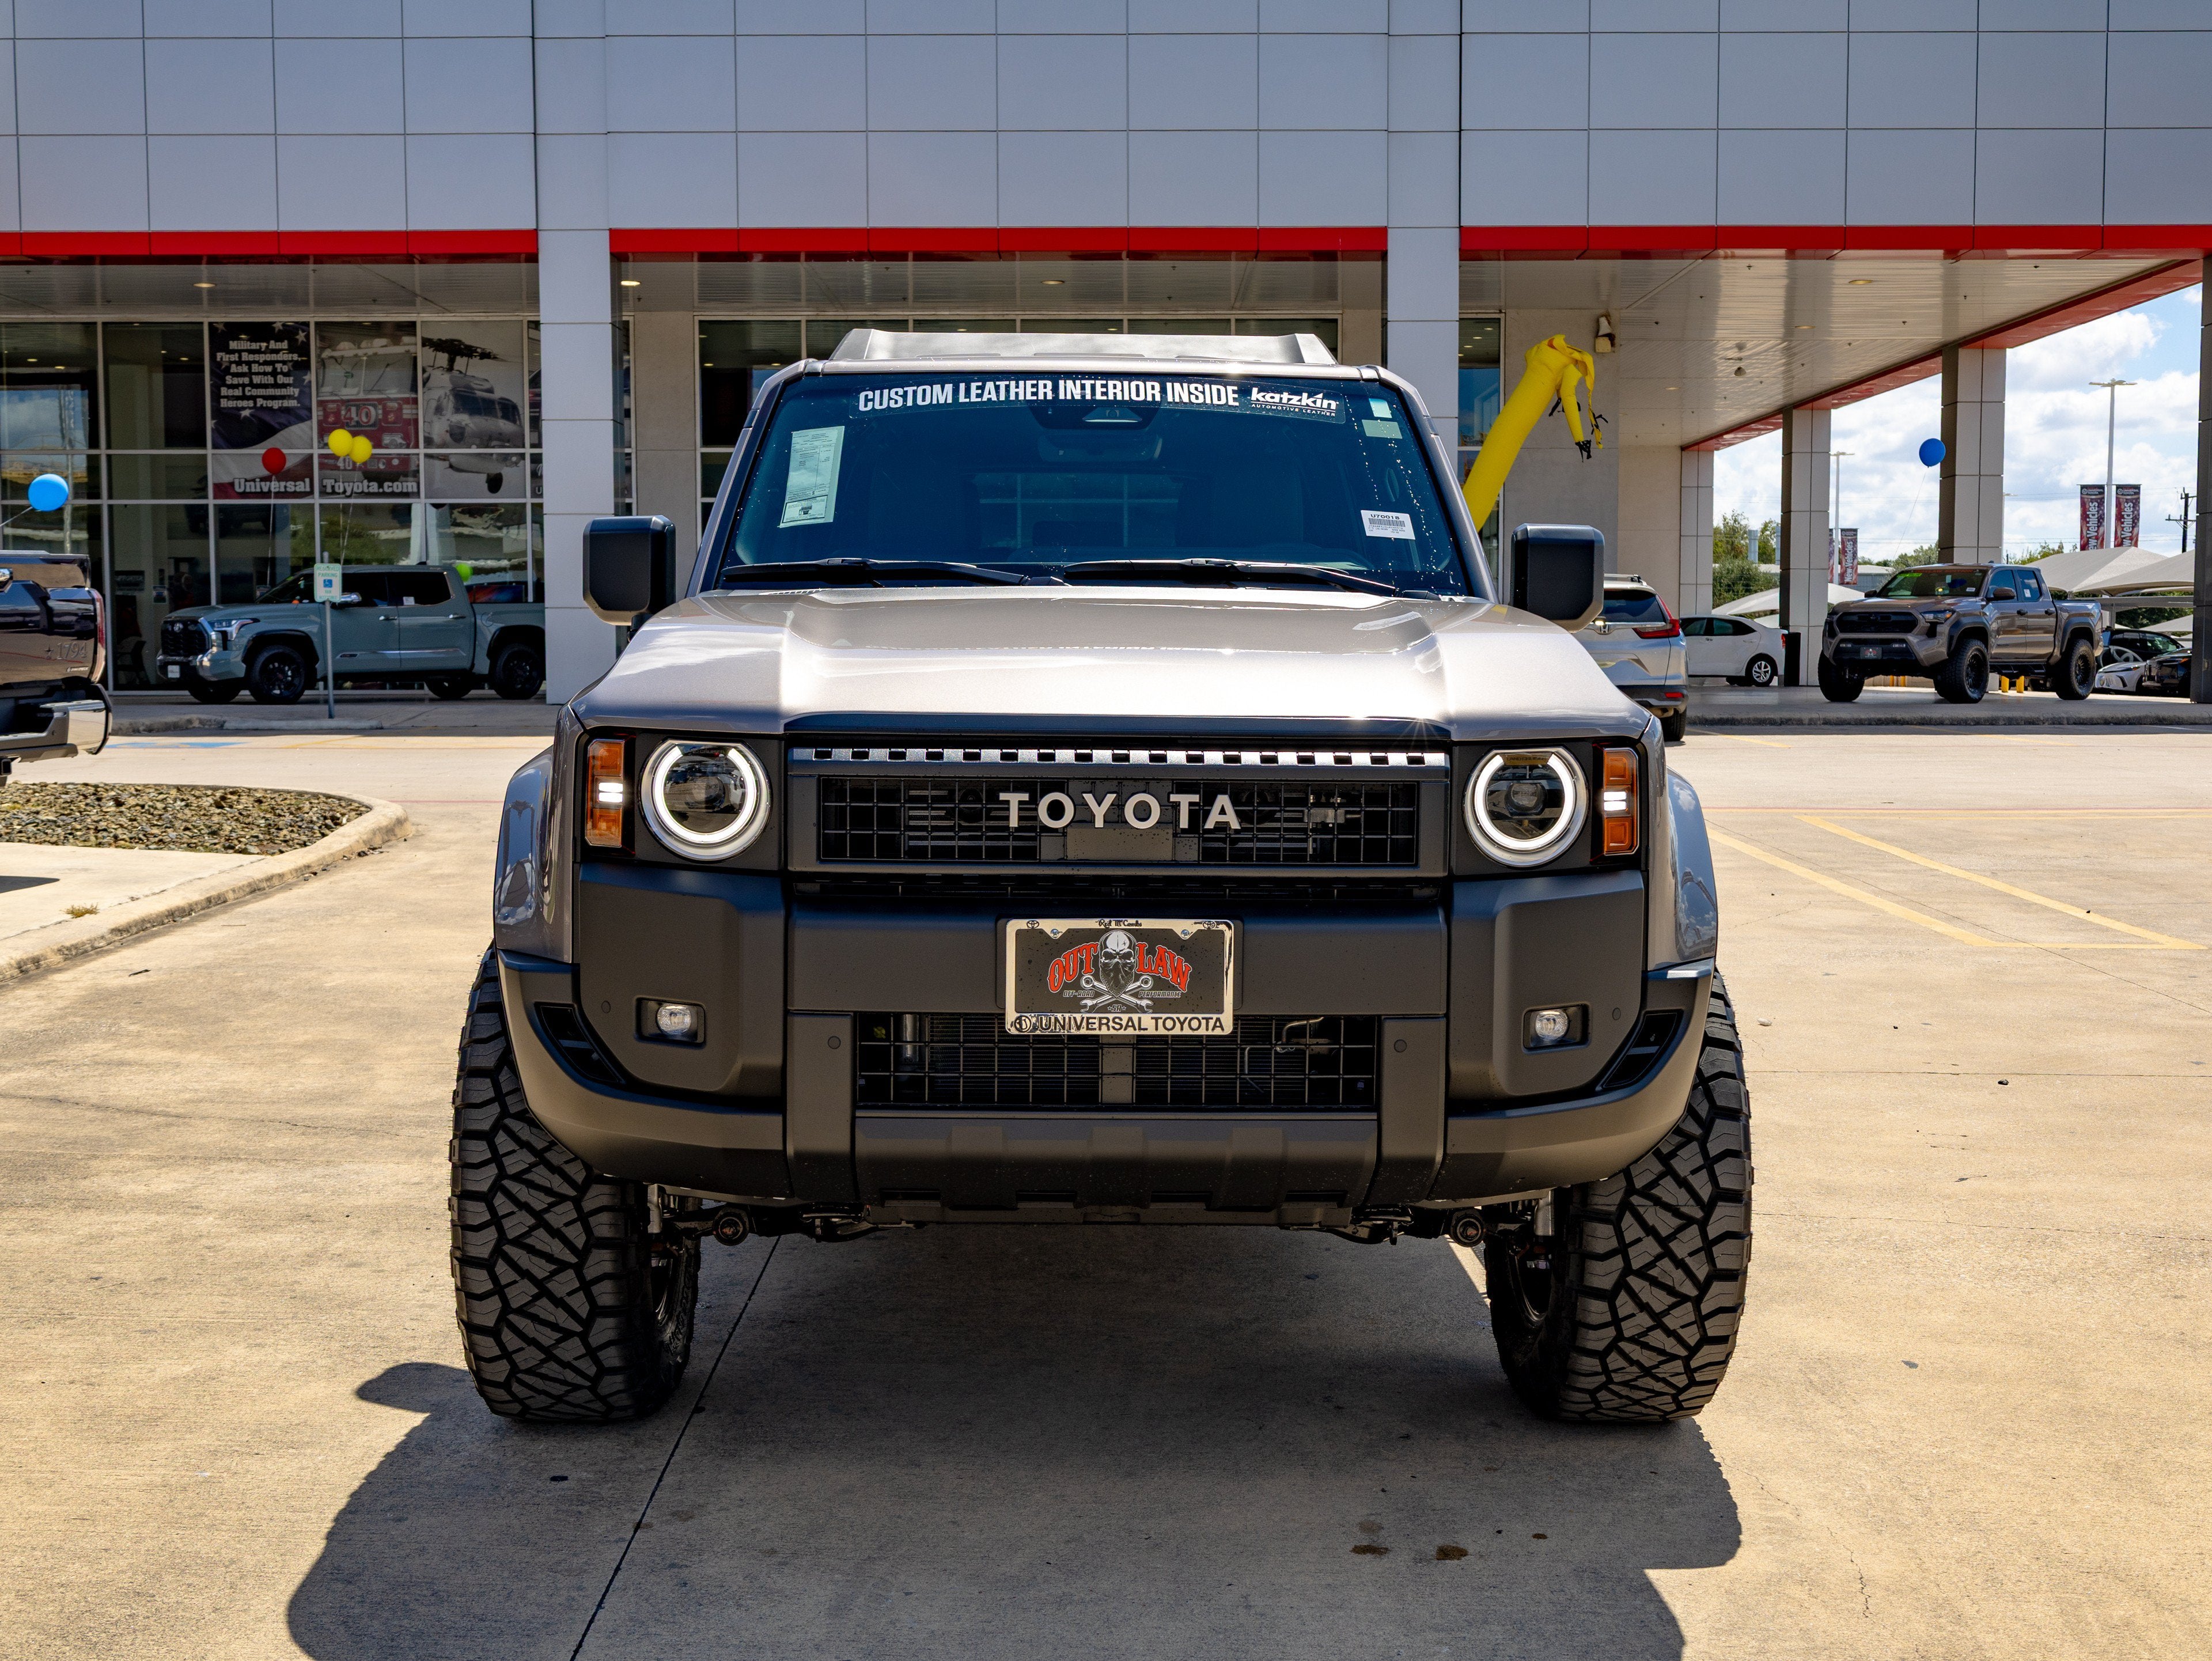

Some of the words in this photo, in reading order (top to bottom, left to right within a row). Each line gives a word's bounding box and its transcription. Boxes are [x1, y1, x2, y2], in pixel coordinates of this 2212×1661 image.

[229, 340, 267, 350] Military
[269, 340, 288, 349] And
[216, 352, 238, 361] First
[241, 351, 301, 362] Responders,
[230, 364, 249, 372] Ask
[251, 364, 272, 372] How
[275, 363, 288, 372] To
[225, 375, 249, 384] Save
[252, 375, 274, 384] With
[276, 374, 293, 383] Our
[221, 387, 243, 396] Real
[245, 387, 300, 396] Community
[858, 384, 952, 412] CUSTOM
[959, 379, 1053, 404] LEATHER
[1058, 379, 1160, 403] INTERIOR
[1166, 382, 1239, 406] INSIDE
[1251, 387, 1336, 410] katzkin
[220, 398, 253, 407] Heroes
[256, 398, 301, 409] Program.
[1251, 404, 1299, 412] AUTOMOTIVE
[1302, 408, 1335, 417] LEATHER
[342, 406, 376, 425] 40
[233, 478, 311, 493] Universal
[322, 478, 418, 496] Toyota.com
[2086, 502, 2098, 539] Vehicles
[2121, 502, 2133, 539] Vehicles
[2089, 539, 2097, 550] ew
[1845, 541, 1853, 567] Vehicles
[1844, 567, 1853, 582] New
[57, 641, 88, 660] 1794
[999, 792, 1241, 829] TOYOTA
[1095, 919, 1111, 928] Red
[1039, 1016, 1147, 1032] UNIVERSAL
[1154, 1016, 1225, 1031] TOYOTA
